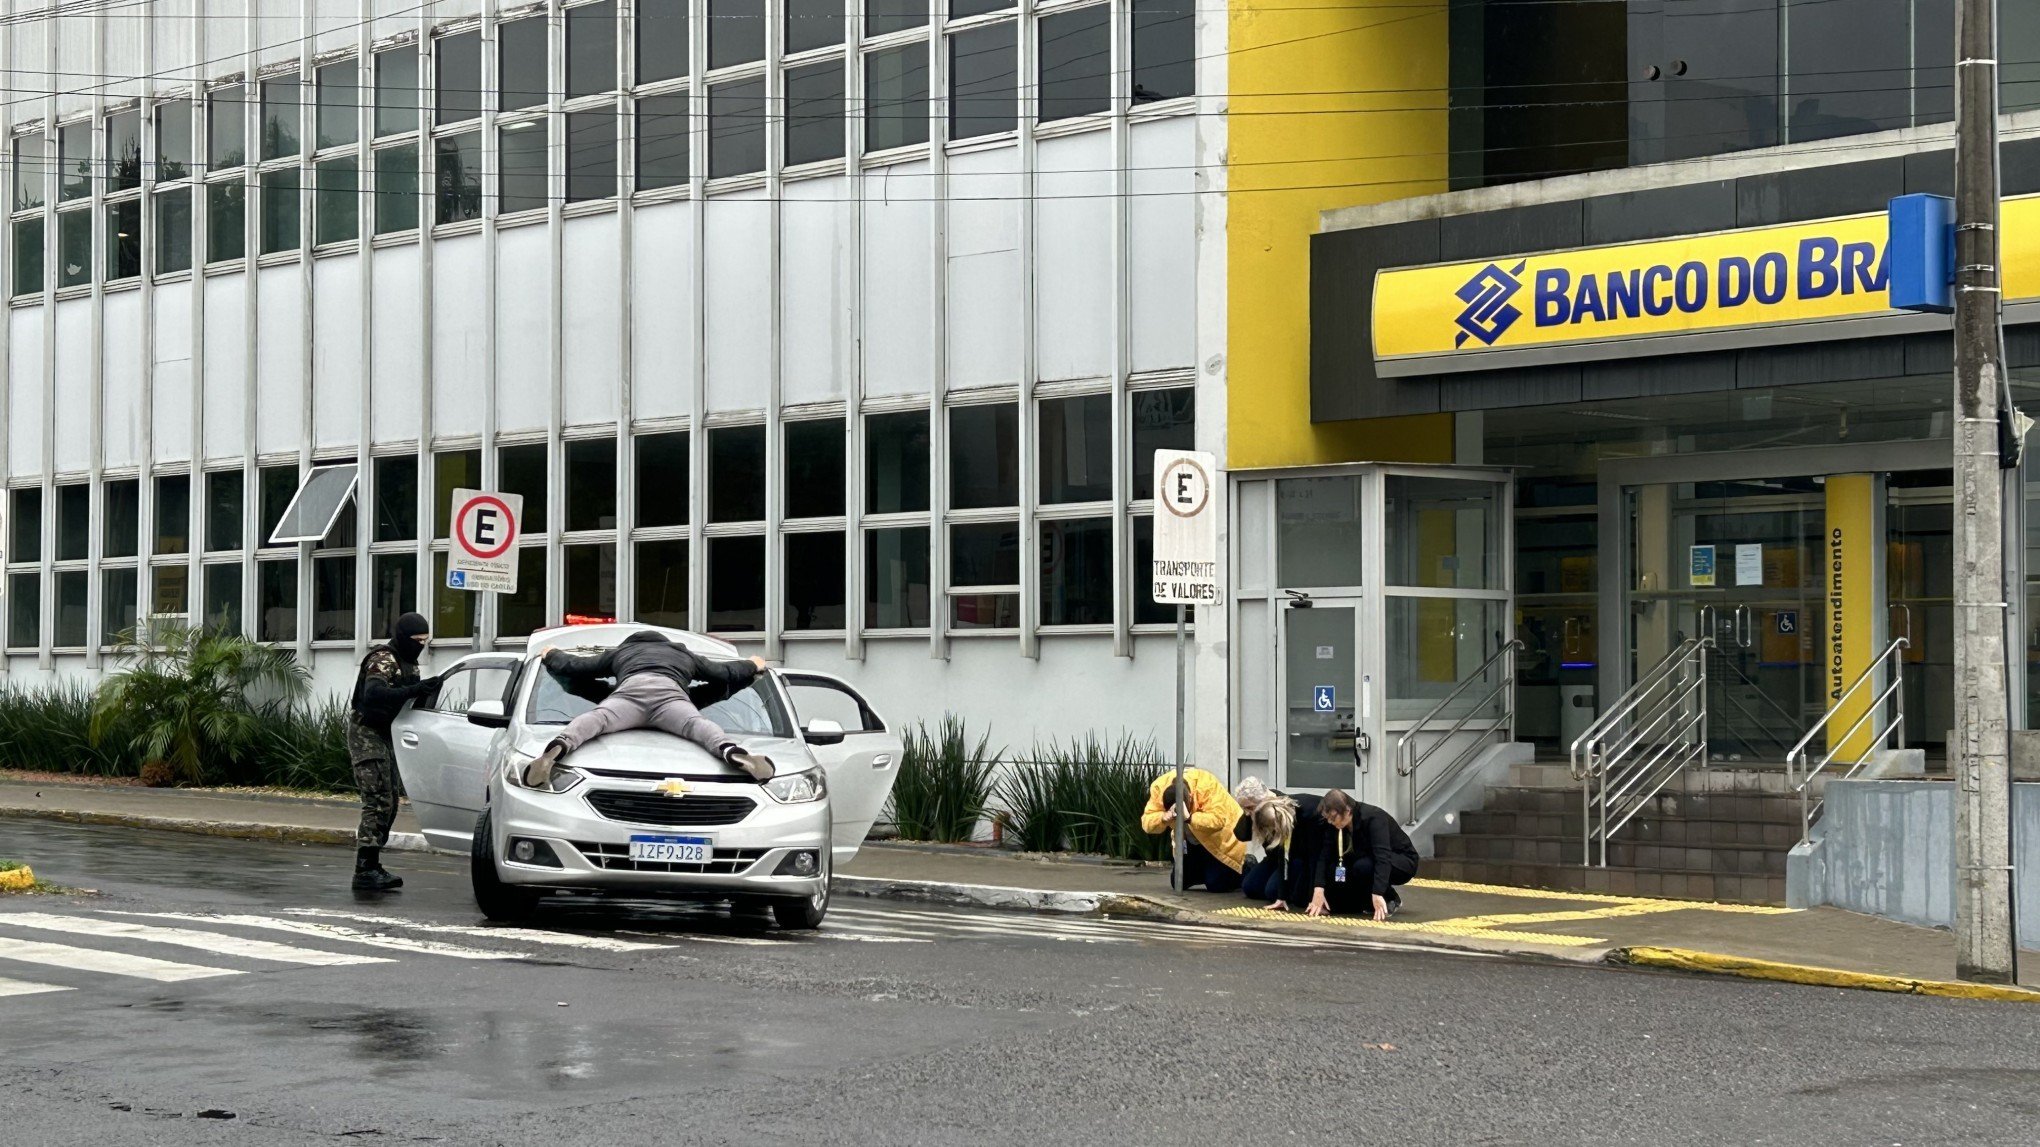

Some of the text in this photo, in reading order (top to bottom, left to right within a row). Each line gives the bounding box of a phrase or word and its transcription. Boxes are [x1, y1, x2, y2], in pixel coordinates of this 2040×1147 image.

[1534, 261, 1708, 327] BANCO
[1718, 252, 1788, 308] DO
[1177, 473, 1193, 503] E
[475, 508, 497, 545] E
[1153, 560, 1215, 577] TRANSPORTE
[1154, 582, 1215, 599] DE VALORES
[1830, 527, 1843, 700] Autoatendimento
[637, 843, 703, 861] IZF9J28
